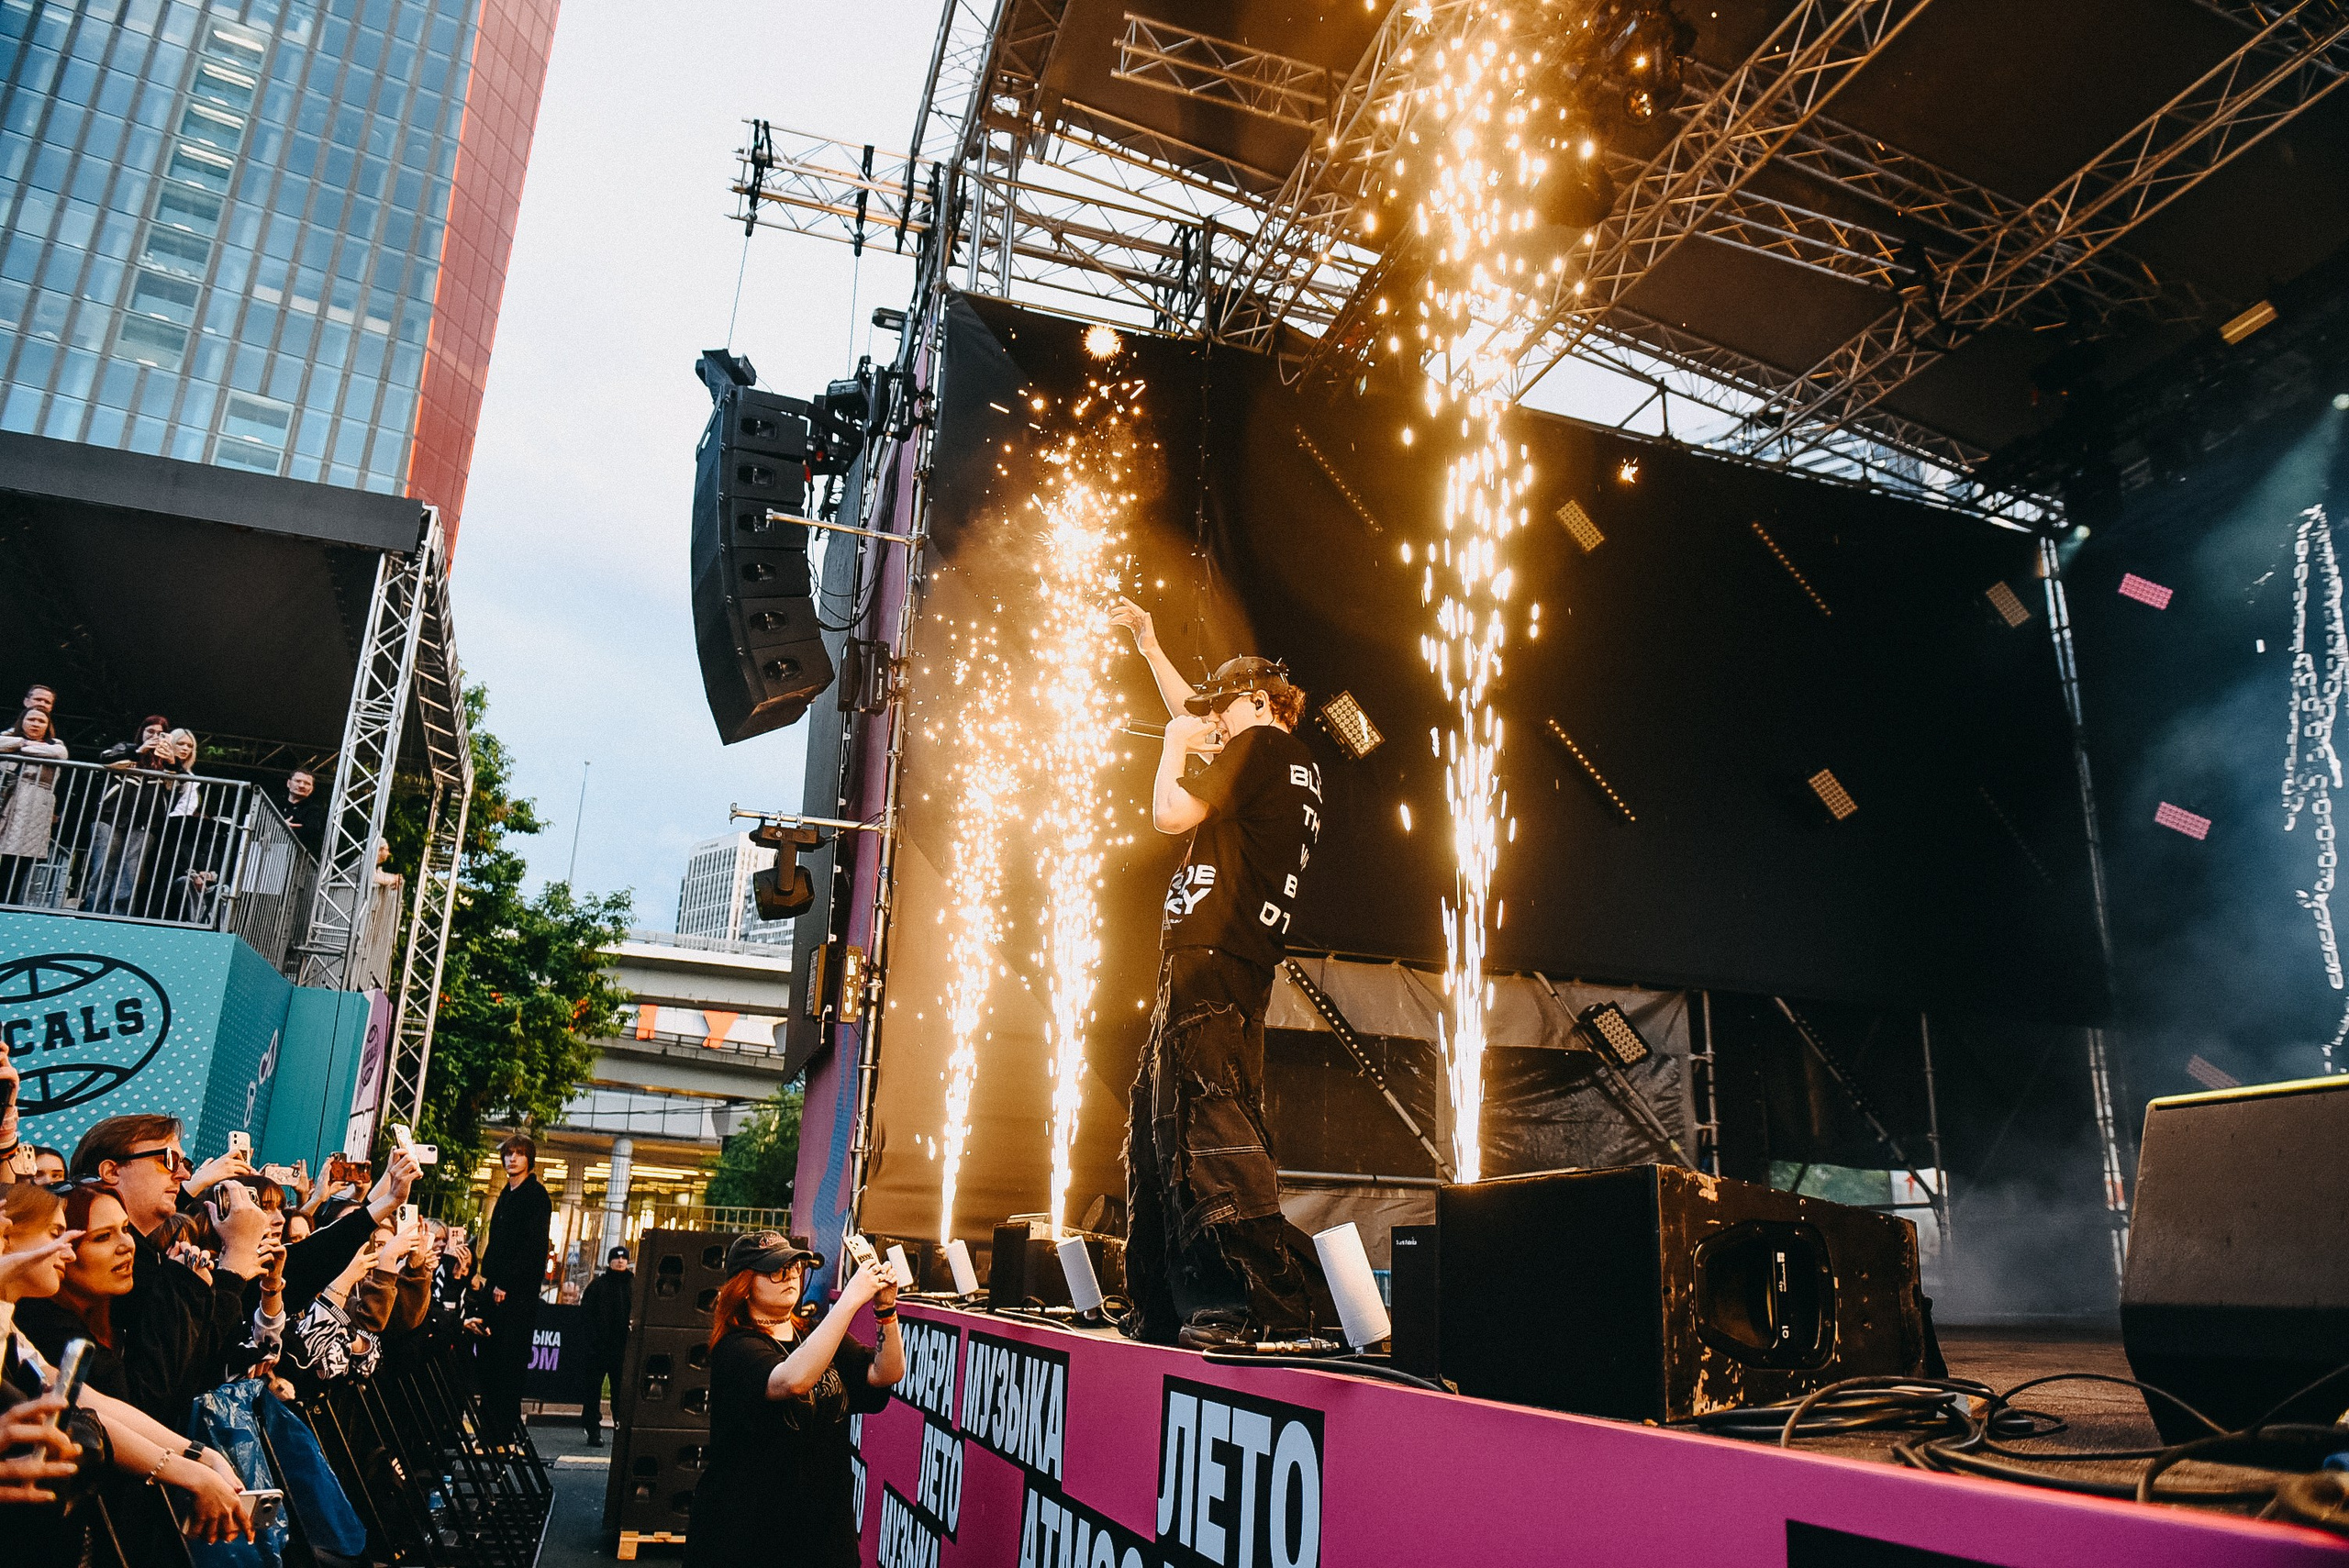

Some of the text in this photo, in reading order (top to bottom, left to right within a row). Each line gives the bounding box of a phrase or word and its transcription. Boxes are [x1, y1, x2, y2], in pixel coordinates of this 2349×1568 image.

[3, 997, 145, 1058] CALS
[891, 1322, 958, 1422] ОСФЕРА
[961, 1340, 1064, 1483] МУЗЫКА
[918, 1421, 963, 1534] ЛЕТО
[1157, 1390, 1320, 1568] ЛЕТО
